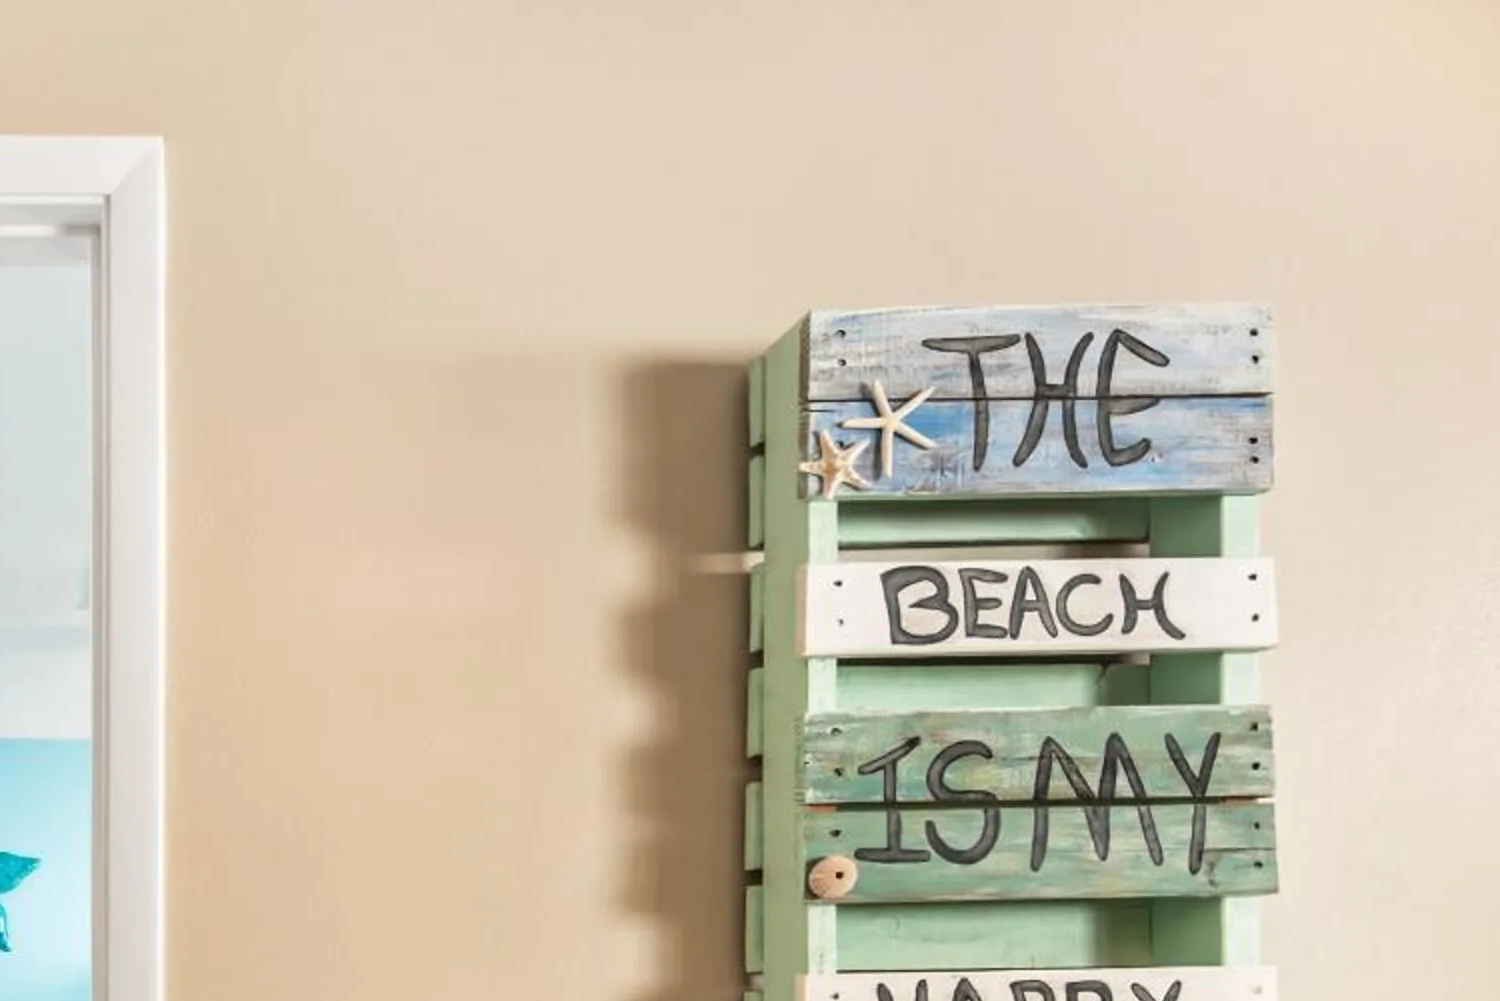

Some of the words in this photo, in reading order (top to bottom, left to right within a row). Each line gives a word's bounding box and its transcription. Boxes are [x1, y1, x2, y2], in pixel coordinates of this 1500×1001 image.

[921, 328, 1170, 472] THE
[880, 565, 1186, 645] BEACH
[854, 736, 1001, 866] IS
[1031, 732, 1222, 875] MY
